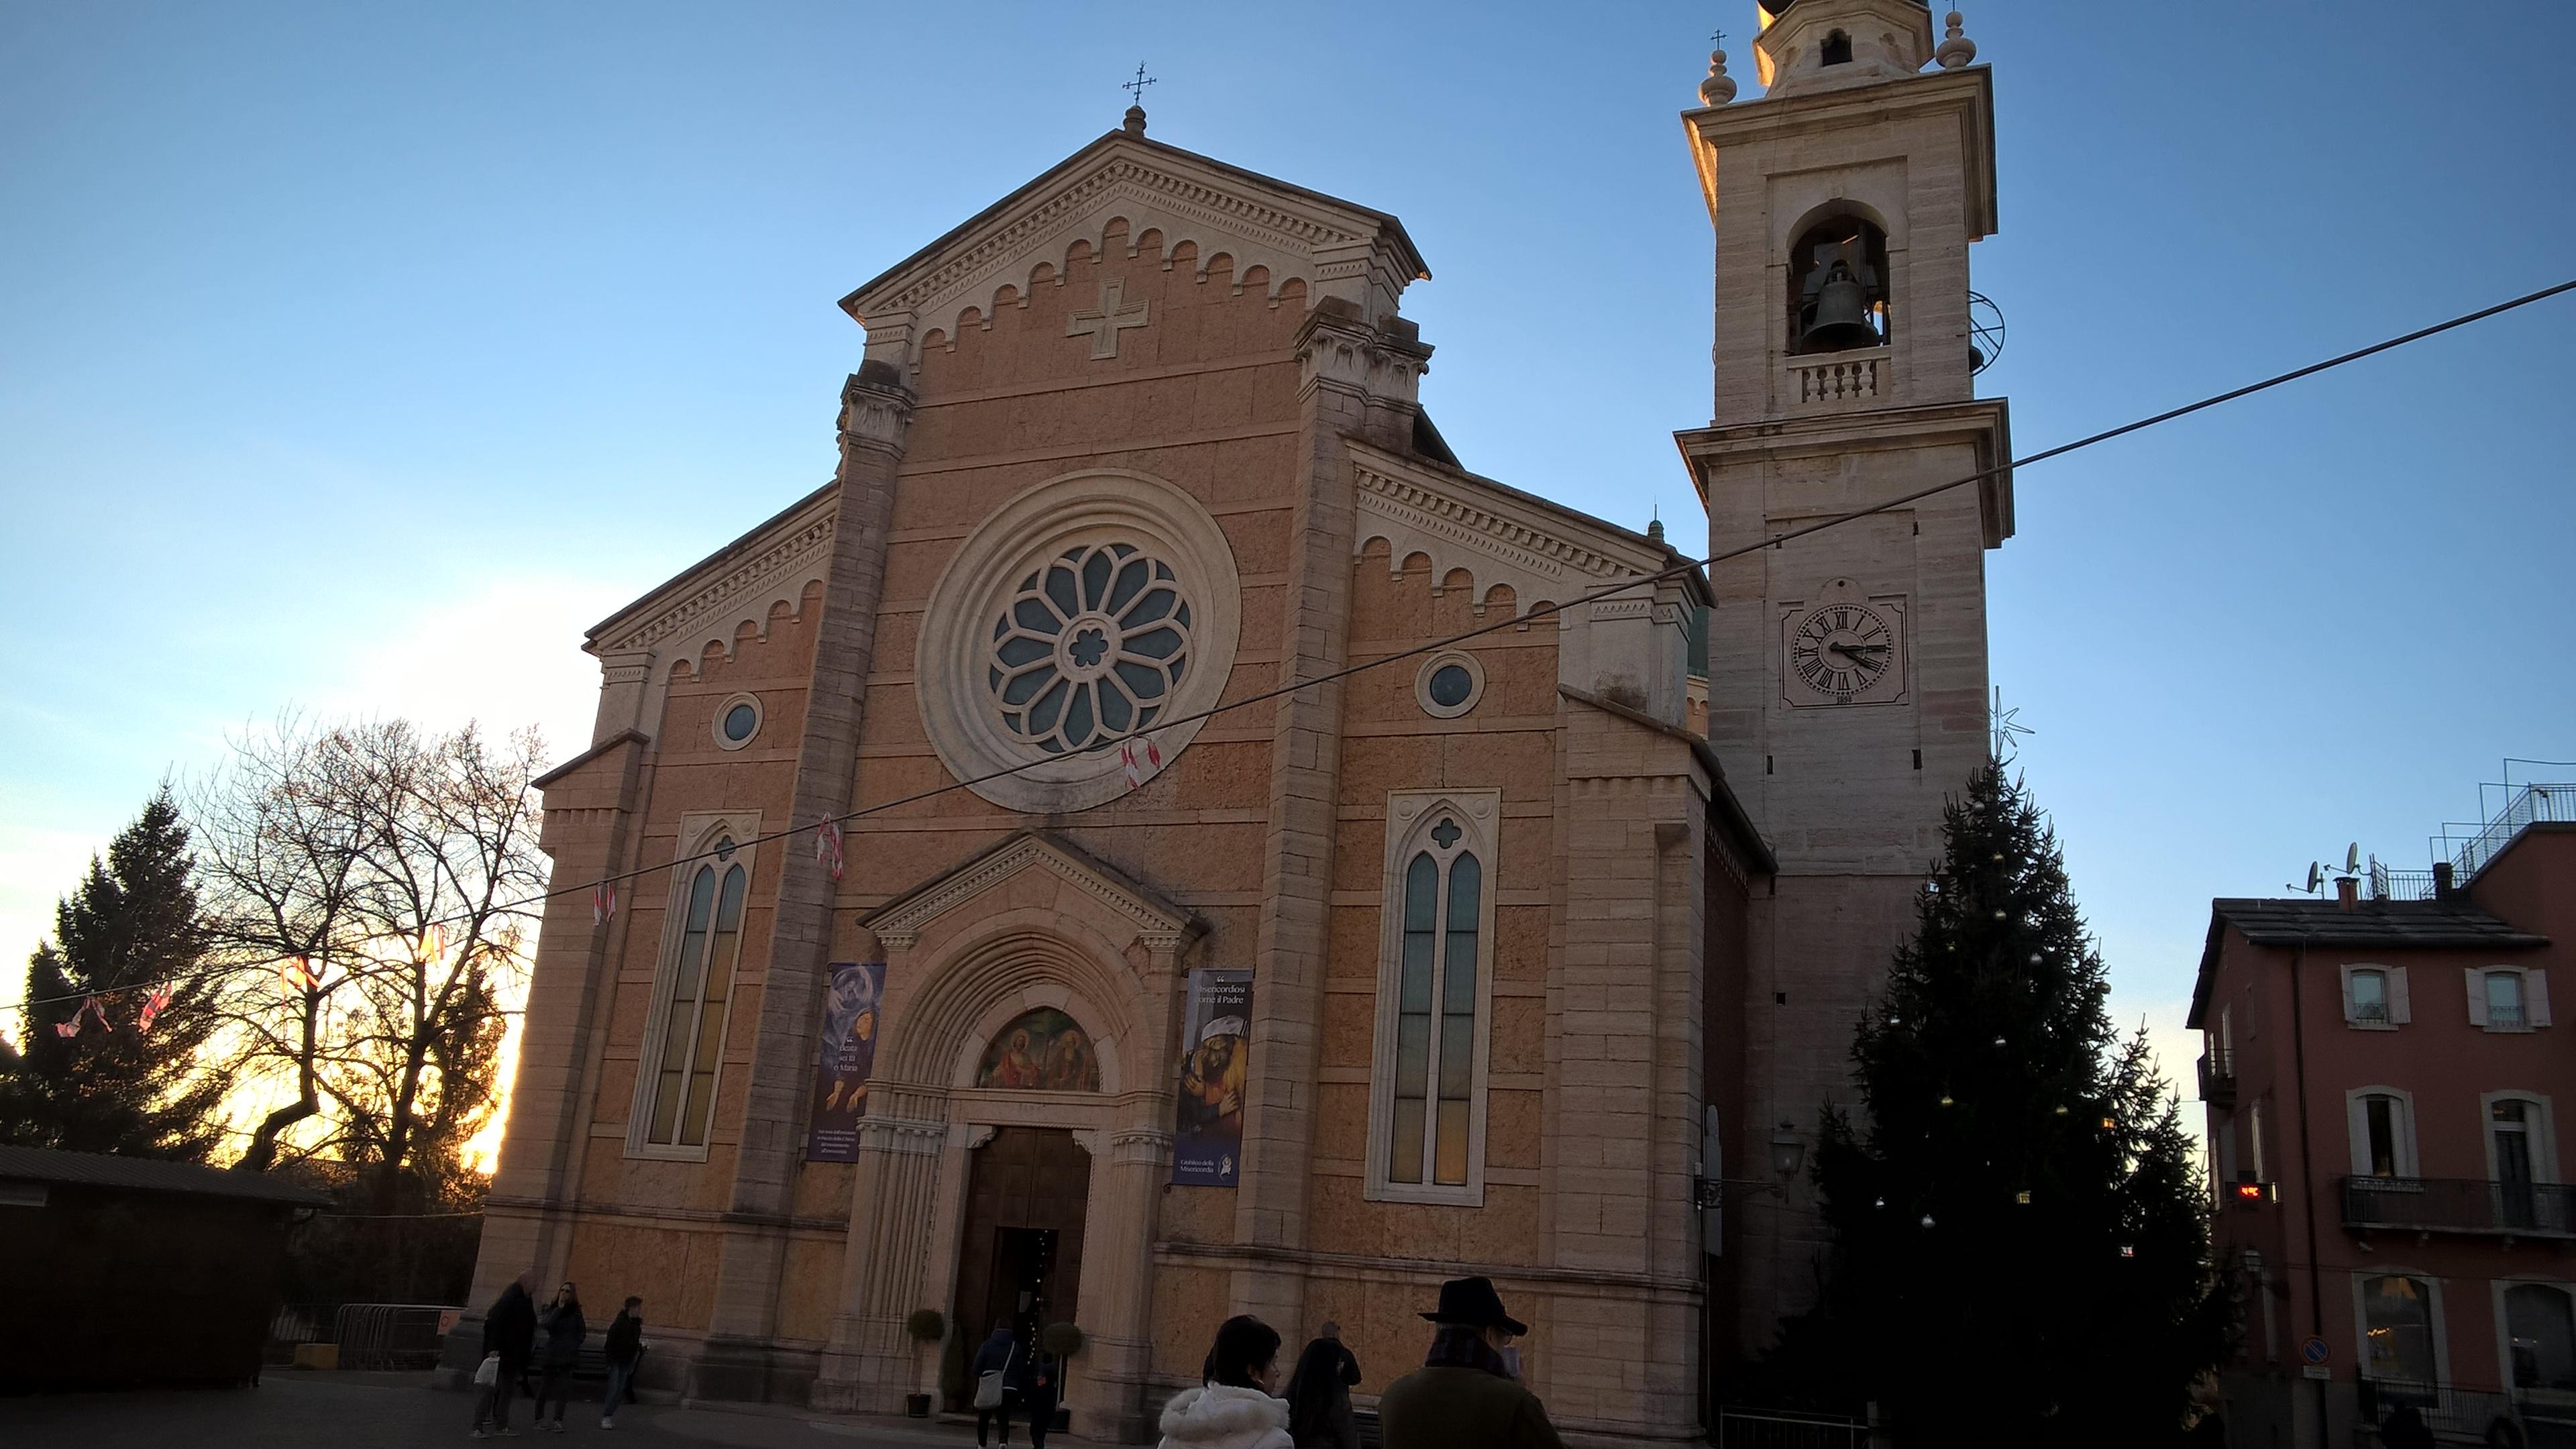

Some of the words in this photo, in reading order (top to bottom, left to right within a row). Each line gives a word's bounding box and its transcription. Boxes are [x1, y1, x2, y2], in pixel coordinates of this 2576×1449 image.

[1815, 615, 1833, 635] XI
[1833, 611, 1849, 629] XII
[1802, 629, 1823, 645] X
[1862, 627, 1882, 641] II
[1799, 646, 1819, 659] IX
[1802, 657, 1825, 679] VIII
[1817, 668, 1835, 689] VII
[1837, 672, 1851, 691] VI
[1854, 669, 1868, 686] V
[1217, 996, 1222, 1004] il
[1223, 996, 1244, 1004] Padre
[1180, 1165, 1214, 1173] Misericordia
